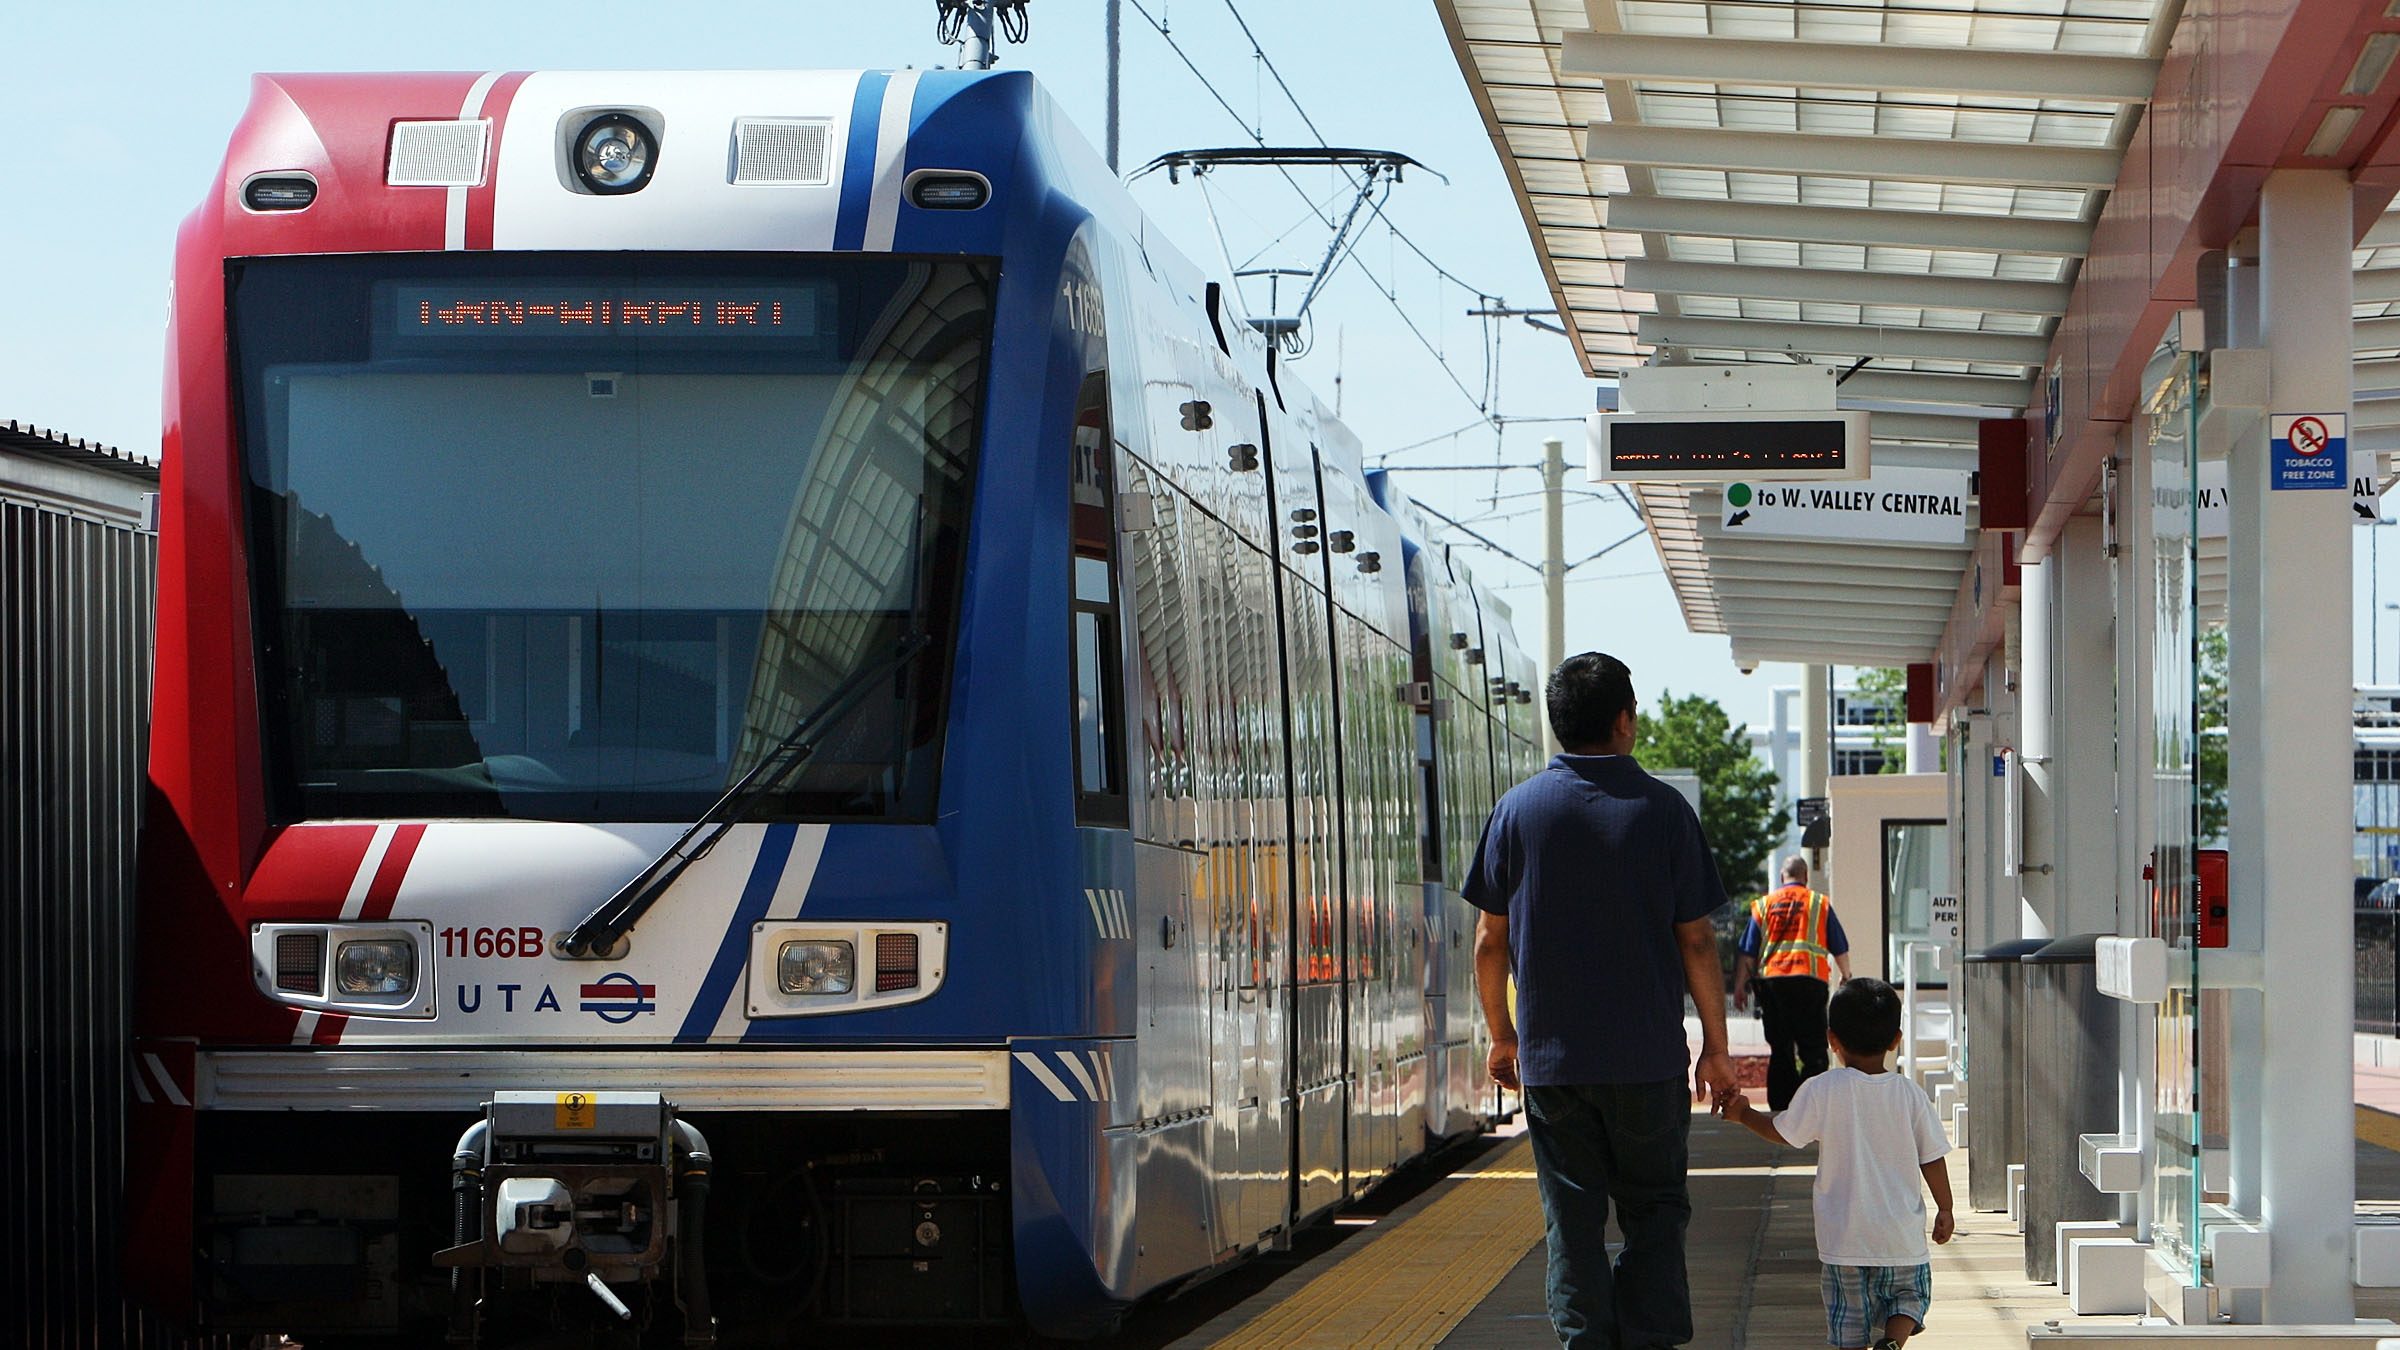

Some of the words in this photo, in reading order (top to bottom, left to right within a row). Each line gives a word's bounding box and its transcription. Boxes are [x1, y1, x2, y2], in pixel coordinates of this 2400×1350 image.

[1063, 281, 1104, 337] 1166B
[2283, 471, 2305, 479] FREE
[2308, 471, 2335, 479] ZONE
[2285, 459, 2333, 467] TOBACCO
[1758, 490, 1776, 506] to
[1782, 488, 1806, 508] W.
[1810, 490, 1875, 511] VALLEY
[1882, 493, 1962, 516] CENTRAL
[440, 927, 544, 958] 1166B
[458, 984, 561, 1013] UTA
